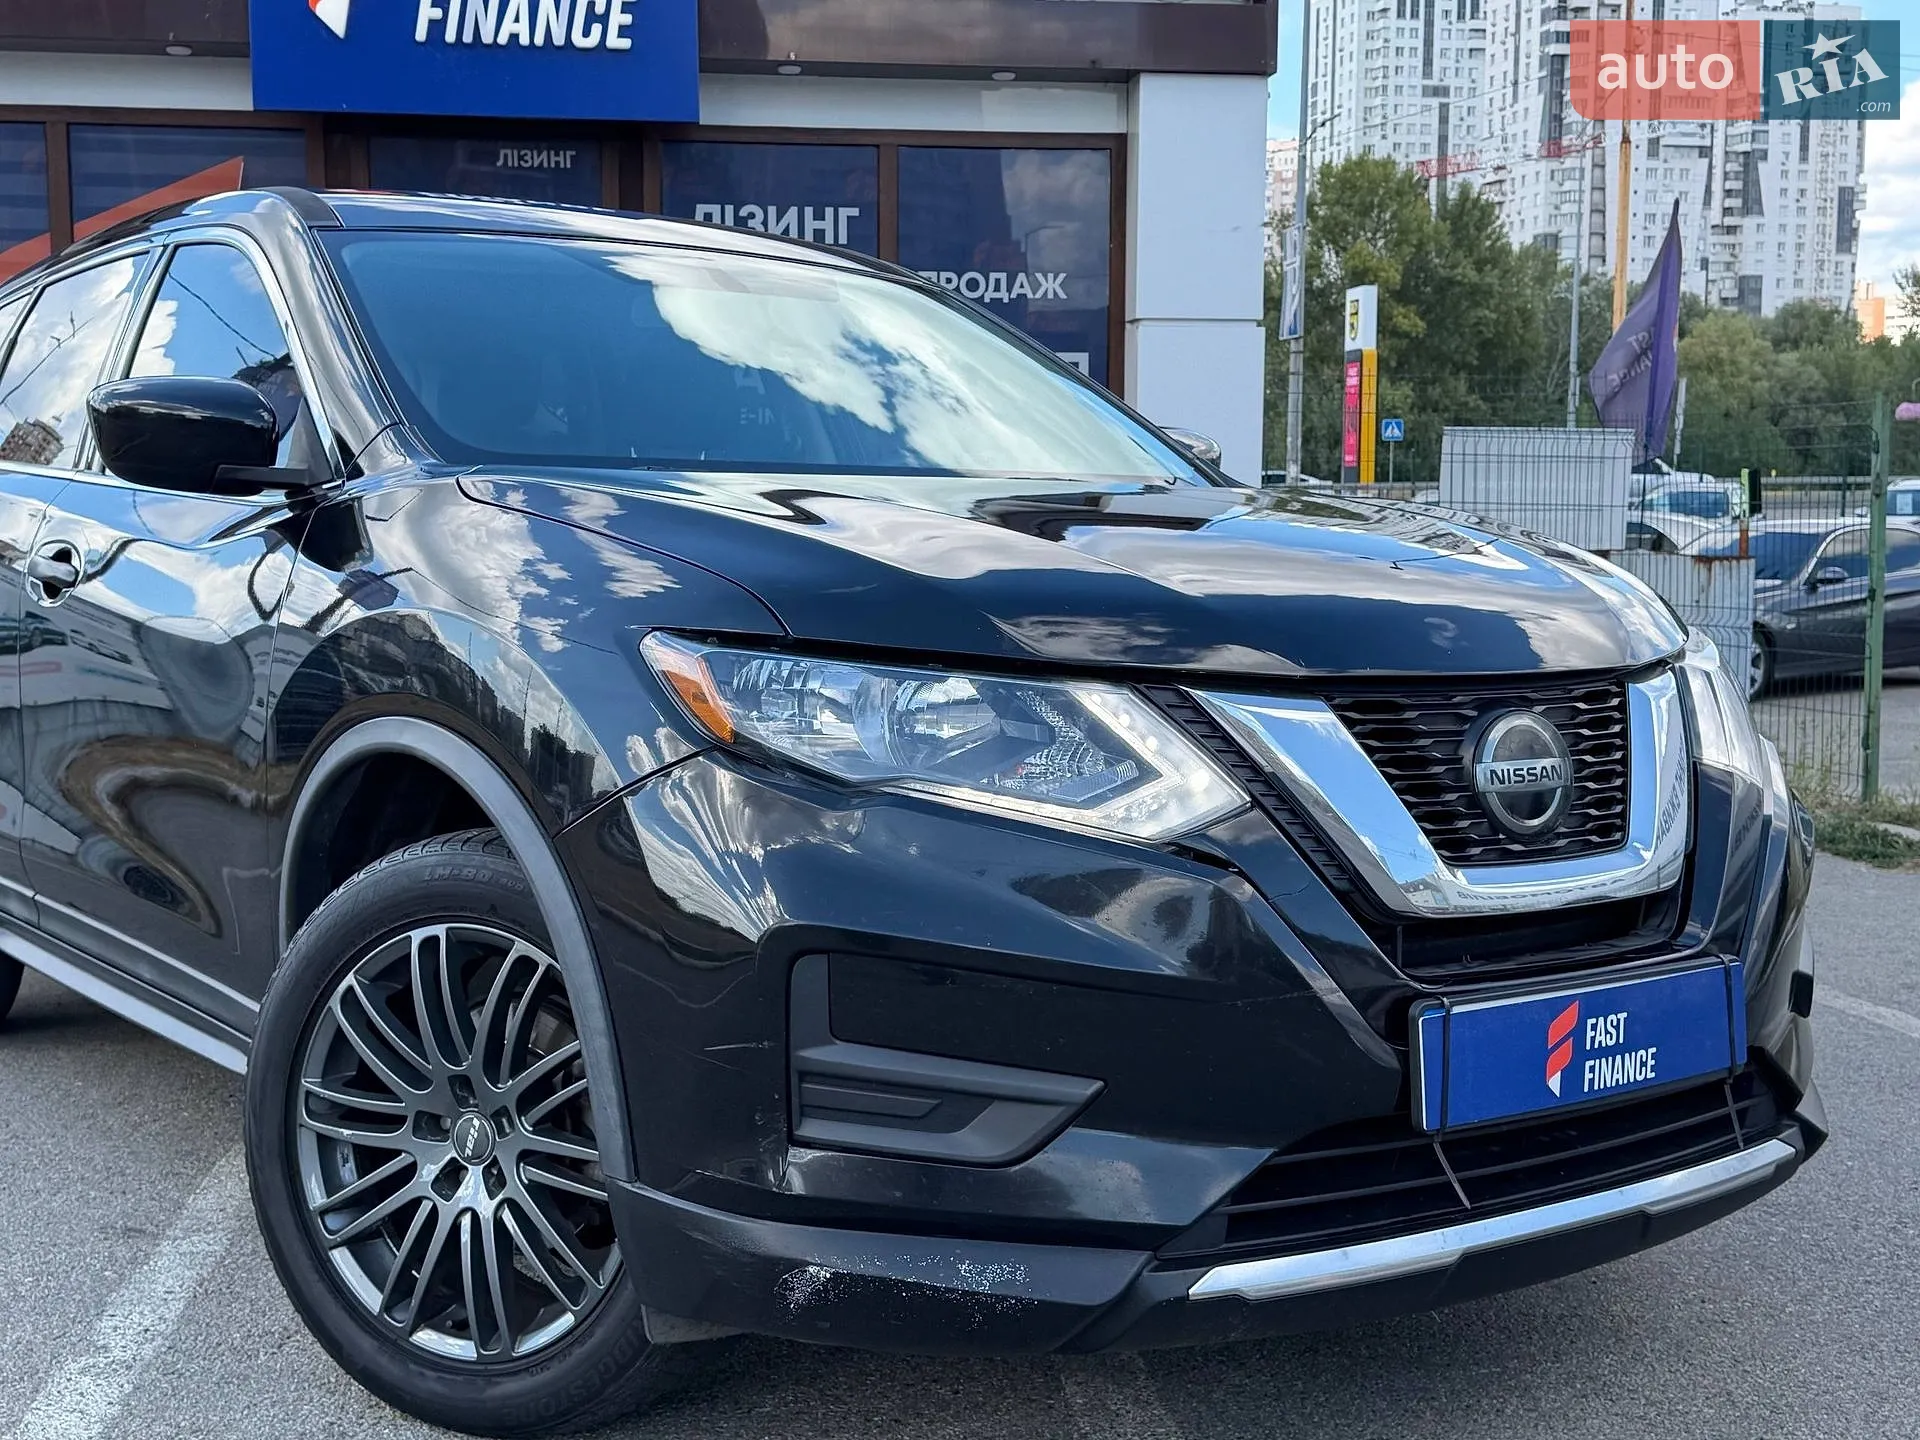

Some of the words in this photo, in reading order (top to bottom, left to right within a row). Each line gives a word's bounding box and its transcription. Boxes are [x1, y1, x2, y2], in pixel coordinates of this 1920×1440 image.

[415, 0, 634, 50] FINANCE
[496, 148, 577, 168] ЛІЗИНГ
[1489, 764, 1563, 786] NISSAN
[1585, 1011, 1628, 1051] FAST
[1583, 1046, 1657, 1093] FINANCE
